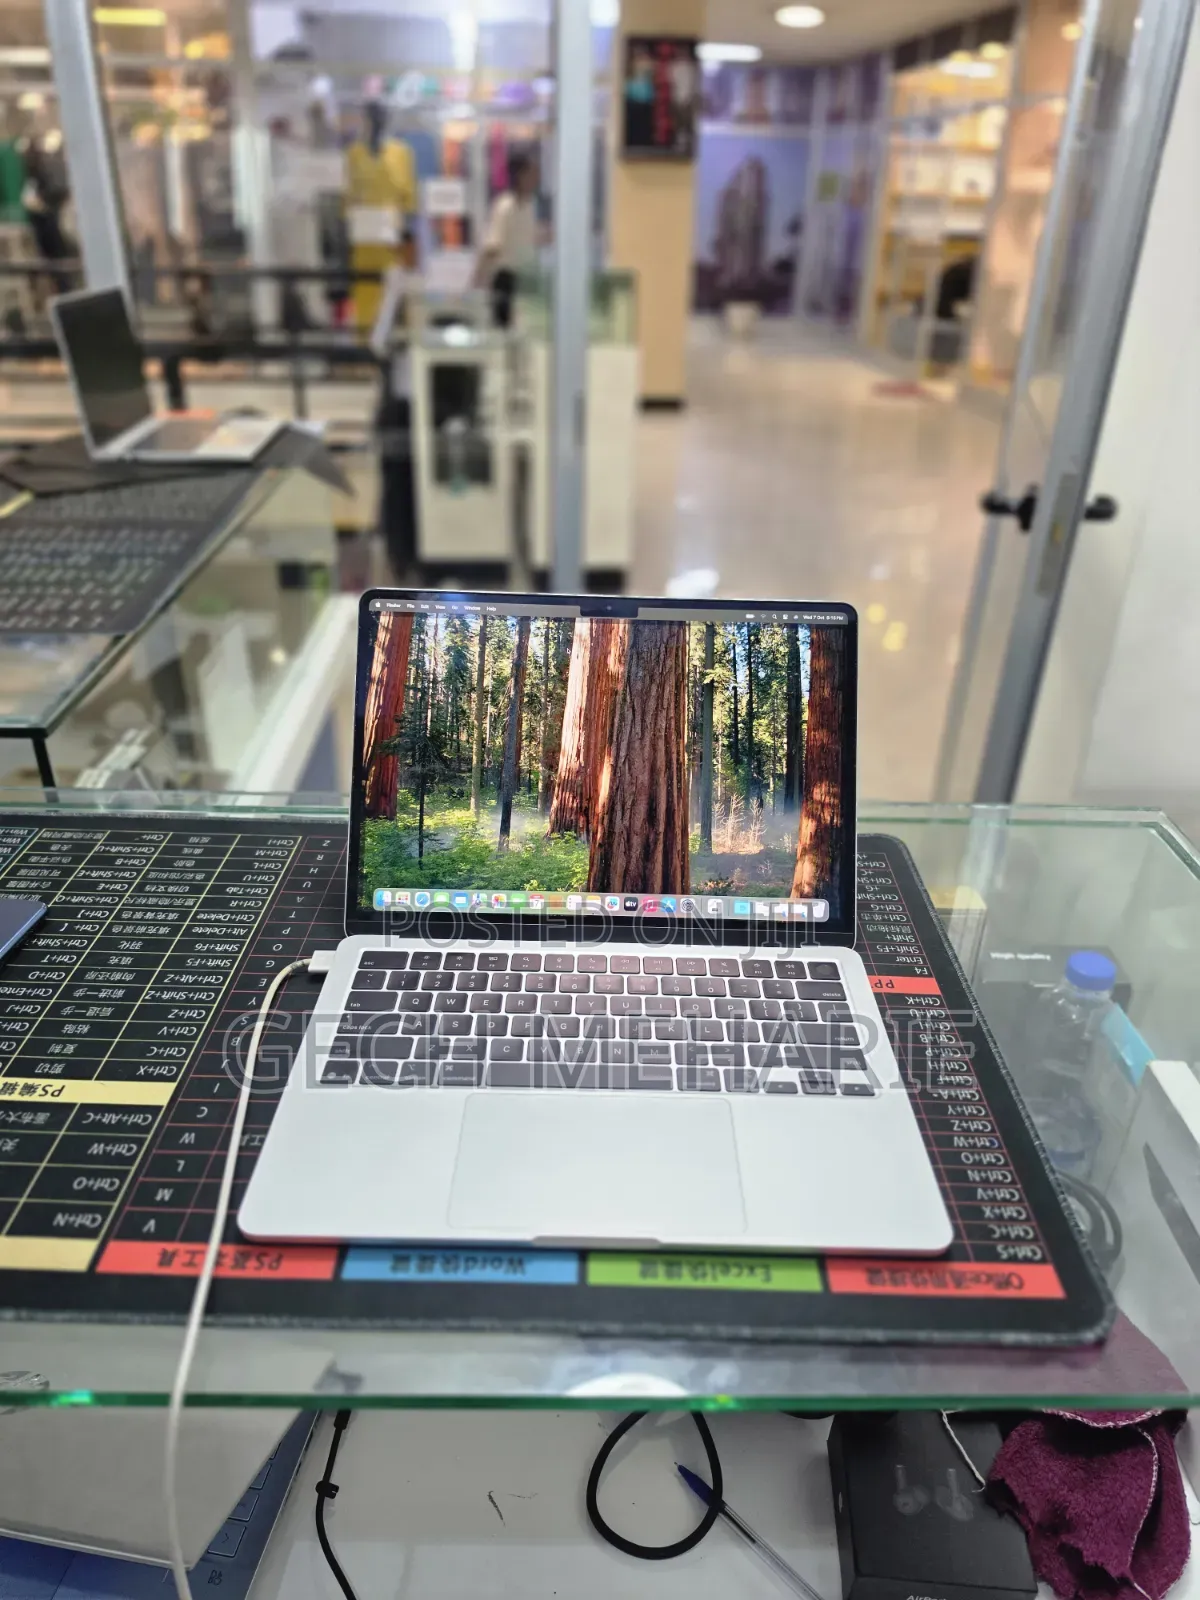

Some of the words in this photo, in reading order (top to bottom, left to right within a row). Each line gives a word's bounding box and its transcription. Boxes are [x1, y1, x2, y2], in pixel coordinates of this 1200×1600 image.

[78, 870, 136, 878] Ctrl+Shift+E
[96, 883, 128, 891] Ctrl+E
[226, 886, 268, 895] Ctrl+Tab
[197, 913, 255, 921] Ctrl+Delete
[192, 926, 248, 935] Alt+Delete
[885, 934, 915, 942] Shift+
[195, 943, 240, 952] Shift+F6
[273, 943, 282, 951] O
[876, 945, 919, 953] Shift+F5
[41, 954, 77, 963] Ctrl+T
[186, 958, 232, 967] Shift+F5
[896, 956, 923, 964] Enter
[266, 960, 275, 968] G
[29, 971, 65, 979] Ctrl+D
[914, 967, 928, 975] F4
[164, 974, 223, 983] Ctrl+Alt+Z
[258, 978, 267, 986] E
[73, 987, 125, 998] 前进一步
[145, 991, 215, 1001] Ctrl+Shift+Z
[248, 996, 256, 1005] Y
[905, 996, 940, 1005] Ctrl+K
[6, 1004, 41, 1014] Ctrl+J
[61, 1006, 114, 1016] 后退一步
[168, 1009, 205, 1018] Ctrl+Z
[240, 1016, 249, 1025] S
[156, 1025, 197, 1038] Ctrl+V
[231, 1037, 240, 1045] B
[919, 1034, 956, 1044] Ctrl+B
[146, 1045, 187, 1059] Ctrl+C
[137, 1065, 177, 1076] Ctrl+X
[197, 1107, 208, 1117] C
[947, 1104, 985, 1116] Ctrl+Y
[82, 1112, 152, 1125] Ctrl+Alt+C
[950, 1119, 991, 1132] Ctrl+Z
[179, 1132, 195, 1144] W
[953, 1135, 998, 1148] Ctrl+W
[88, 1143, 137, 1156] Ctrl+W
[961, 1152, 1005, 1165] Ctrl+O
[177, 1160, 185, 1172] L
[967, 1169, 1011, 1183] Ctrl+N
[72, 1177, 120, 1191] Ctrl+O
[155, 1188, 173, 1200] M
[976, 1187, 1019, 1201] Ctrl+V
[981, 1205, 1026, 1220] Ctrl+X
[54, 1212, 102, 1228] Ctrl+N
[142, 1218, 156, 1232] V
[988, 1224, 1034, 1239] Ctrl+C
[996, 1244, 1042, 1259] Ctrl+S
